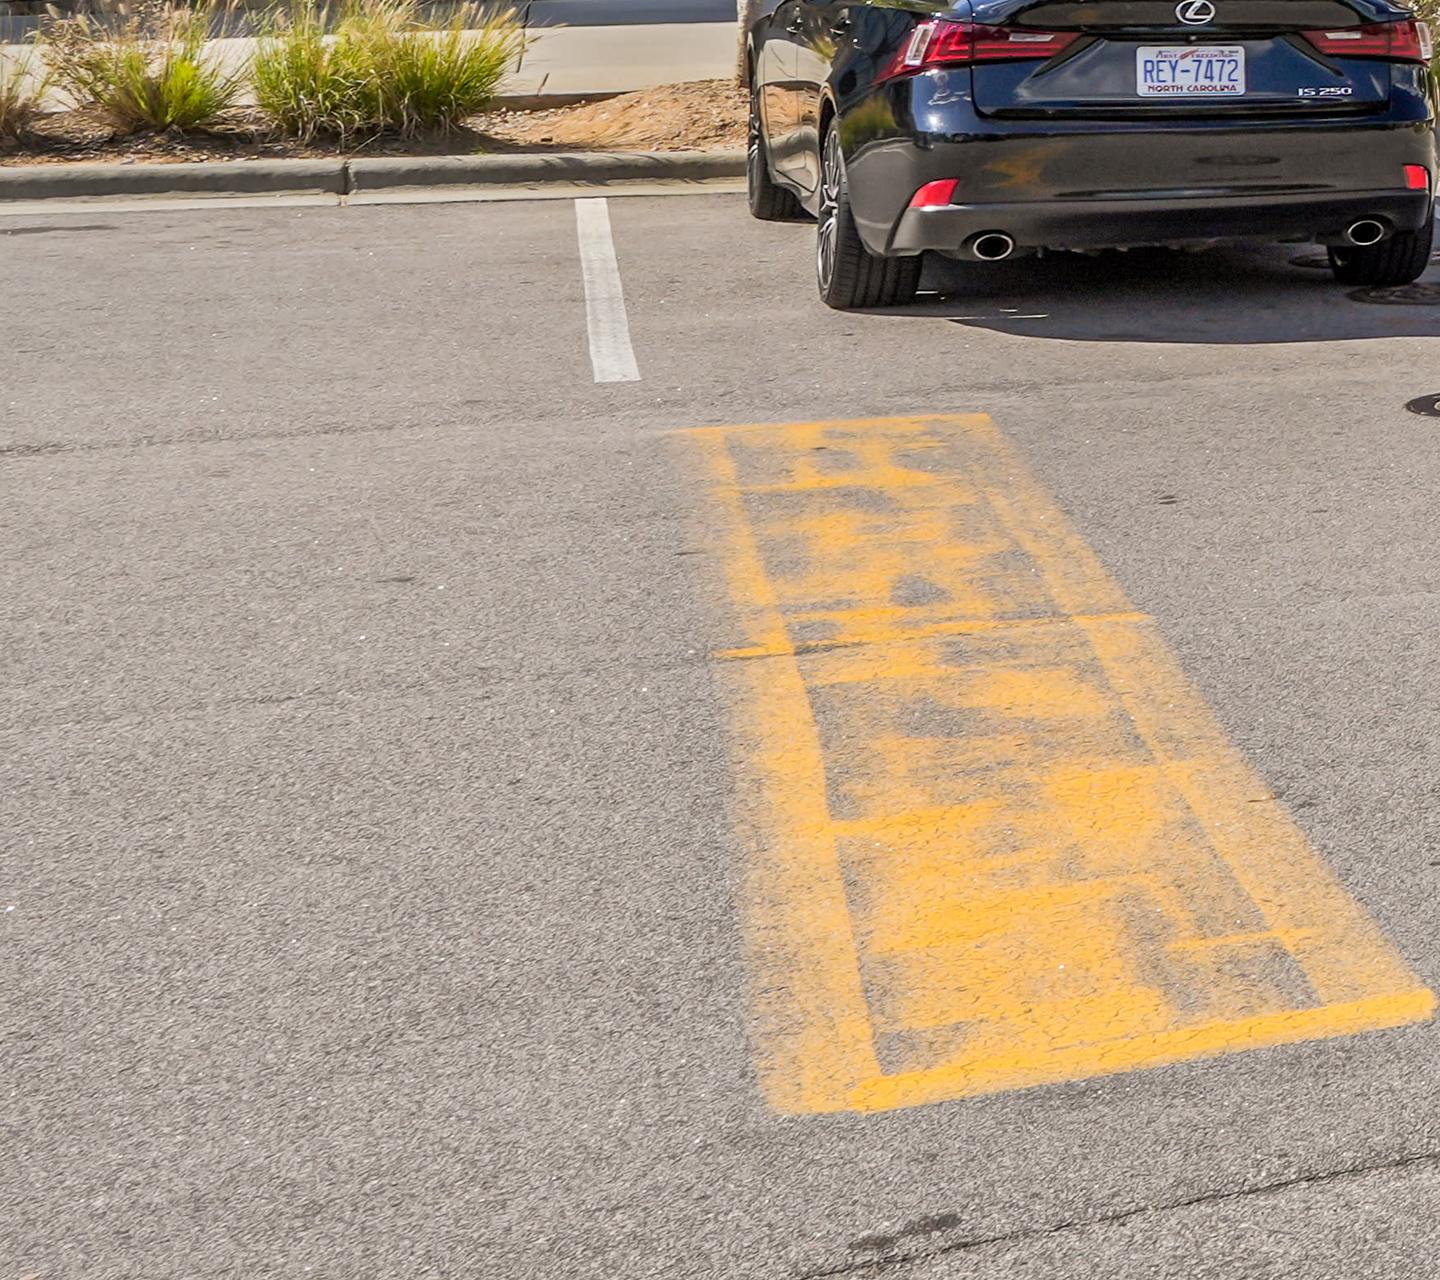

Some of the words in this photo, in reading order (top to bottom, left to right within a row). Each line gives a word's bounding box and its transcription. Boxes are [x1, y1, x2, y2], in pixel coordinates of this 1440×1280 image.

[1143, 59, 1239, 83] REY-7472
[1147, 84, 1184, 93] NORTH
[1186, 84, 1238, 93] CAROLINA
[1298, 87, 1316, 97] IS
[1319, 86, 1353, 96] 250
